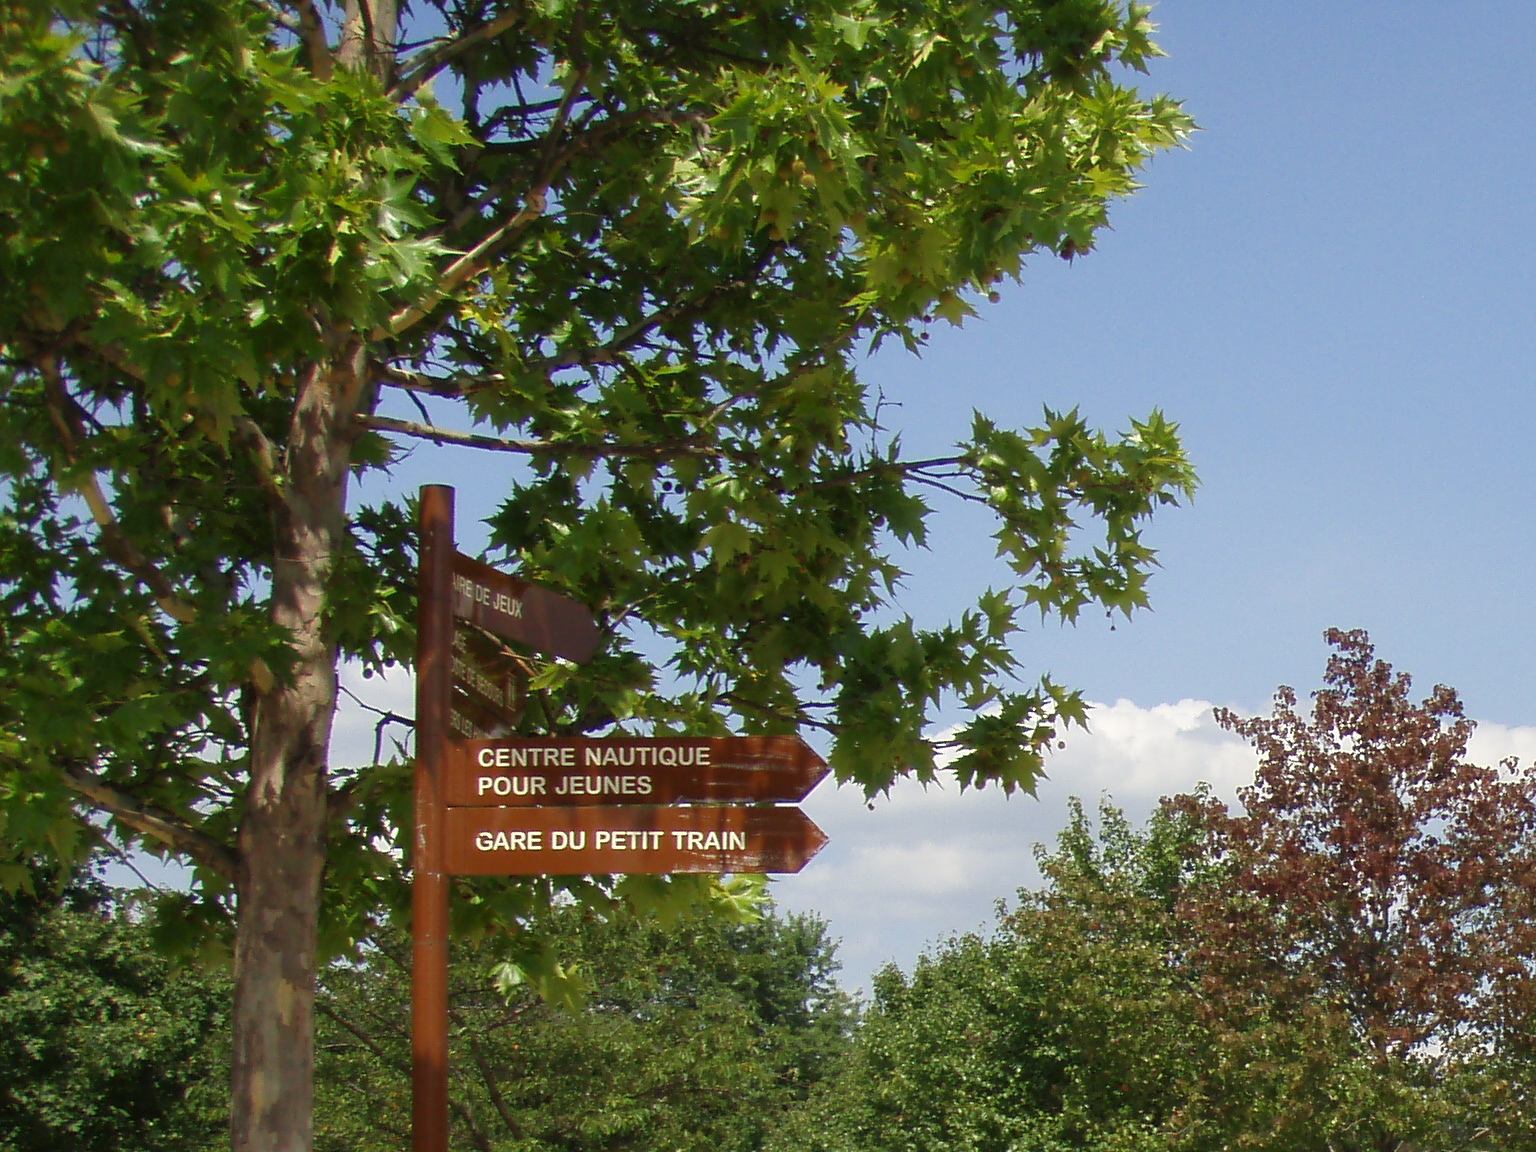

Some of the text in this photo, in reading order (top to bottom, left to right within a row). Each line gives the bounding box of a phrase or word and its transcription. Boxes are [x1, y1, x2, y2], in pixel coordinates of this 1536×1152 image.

[475, 584, 491, 606] DE
[492, 592, 523, 619] JEUX
[478, 747, 710, 767] CENTRE NAUTIQUE
[478, 776, 651, 795] POUR JEUNES
[476, 831, 745, 850] GARE DU PETIT TRAIN
